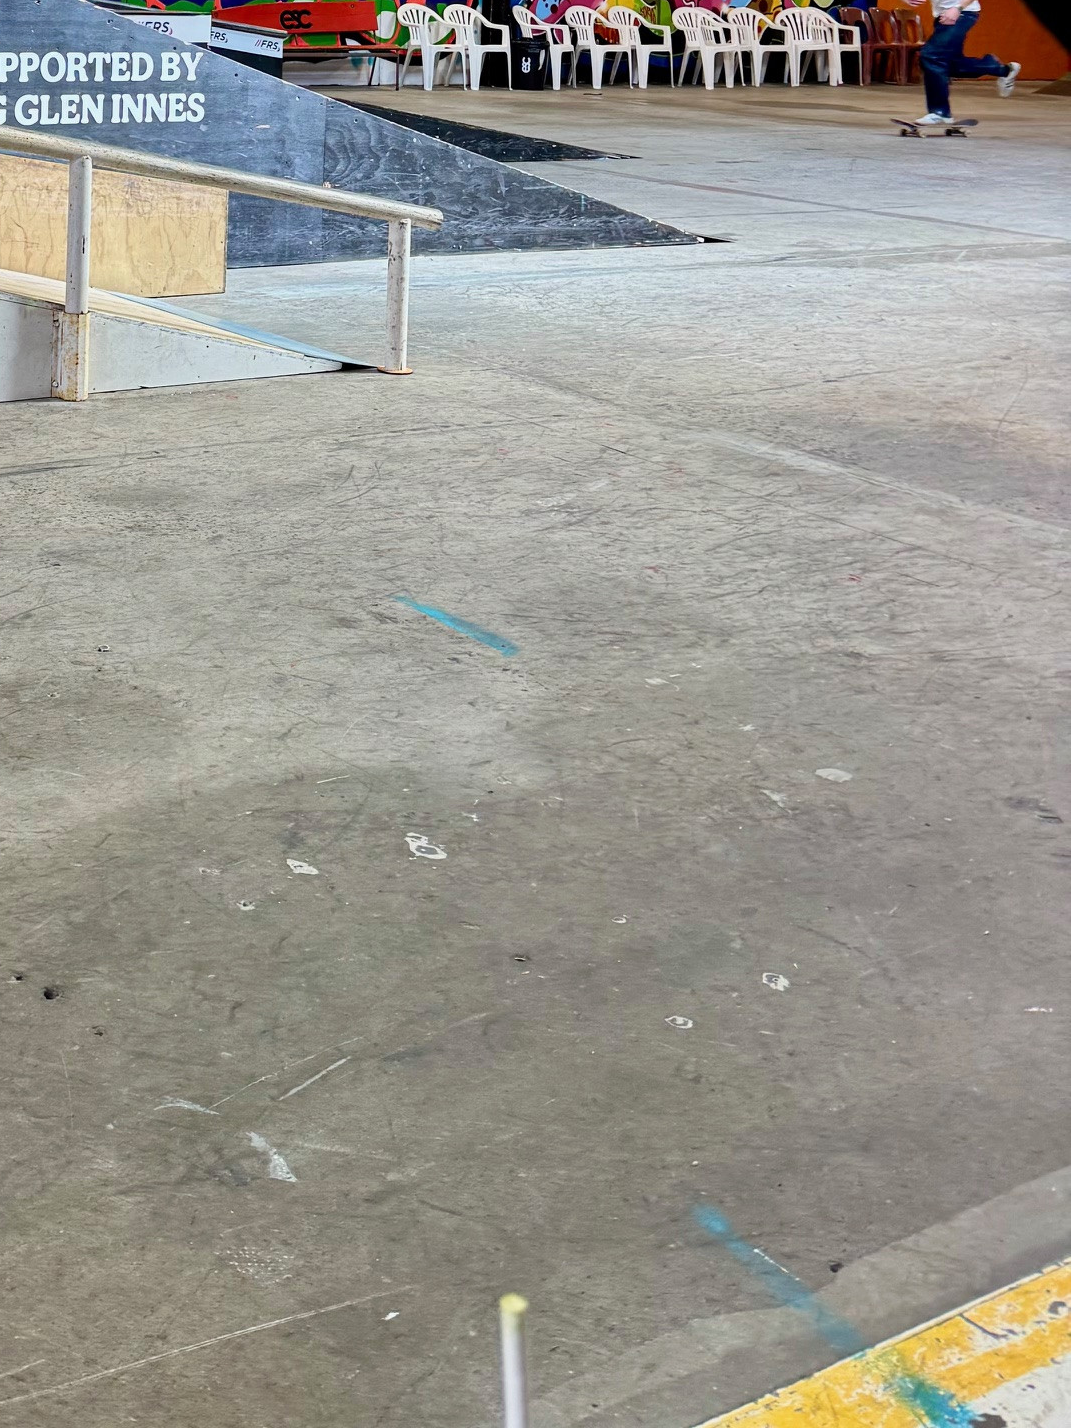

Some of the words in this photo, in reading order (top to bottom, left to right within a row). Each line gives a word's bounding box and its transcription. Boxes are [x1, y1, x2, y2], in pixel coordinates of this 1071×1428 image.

[160, 51, 204, 82] BY
[14, 93, 105, 126] GLEN
[111, 92, 206, 123] INNES
